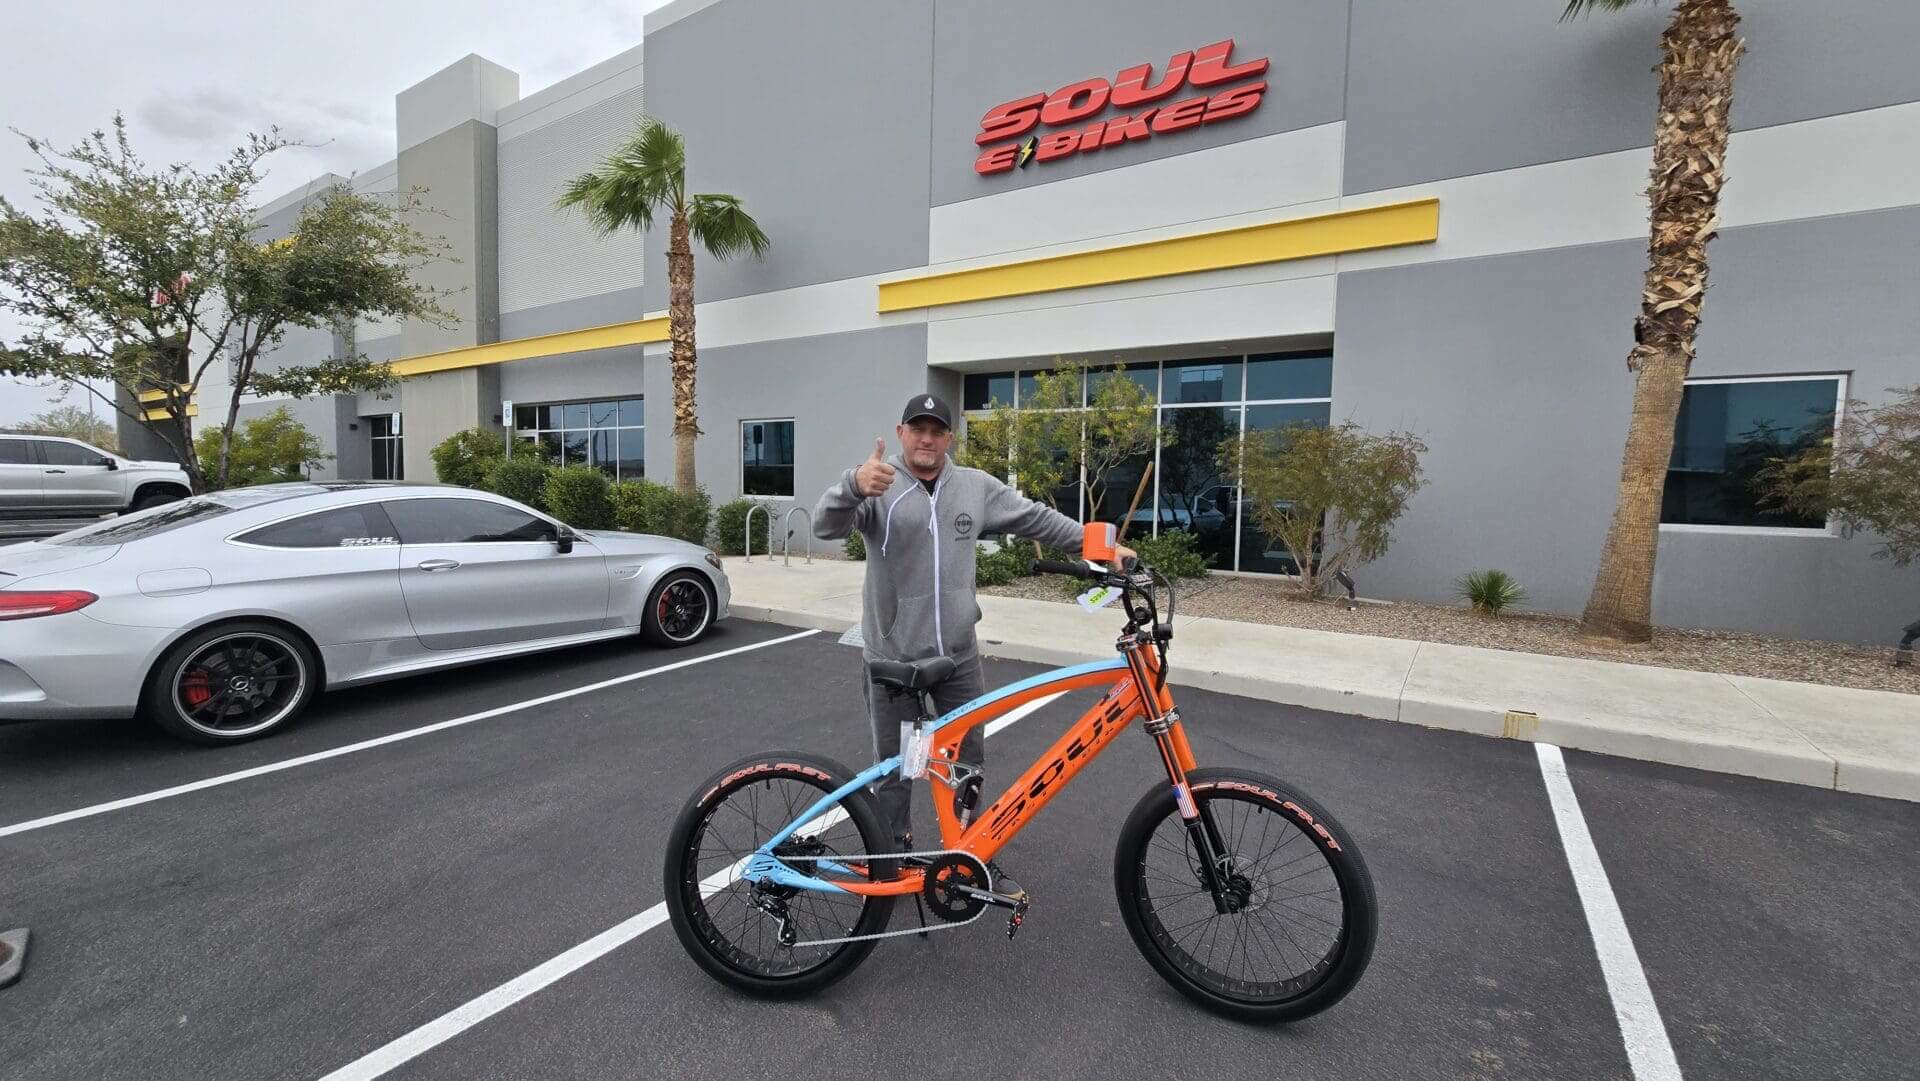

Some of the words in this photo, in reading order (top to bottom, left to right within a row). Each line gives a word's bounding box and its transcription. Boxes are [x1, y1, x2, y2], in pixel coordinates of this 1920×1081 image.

[974, 144, 1021, 176] E
[1034, 80, 1268, 164] BIKES
[975, 39, 1269, 146] SOUL
[720, 763, 774, 788] SOUL
[774, 762, 832, 781] FAST
[991, 695, 1140, 840] SOUL
[1216, 781, 1282, 804] SOUL
[1282, 801, 1342, 852] FAST
